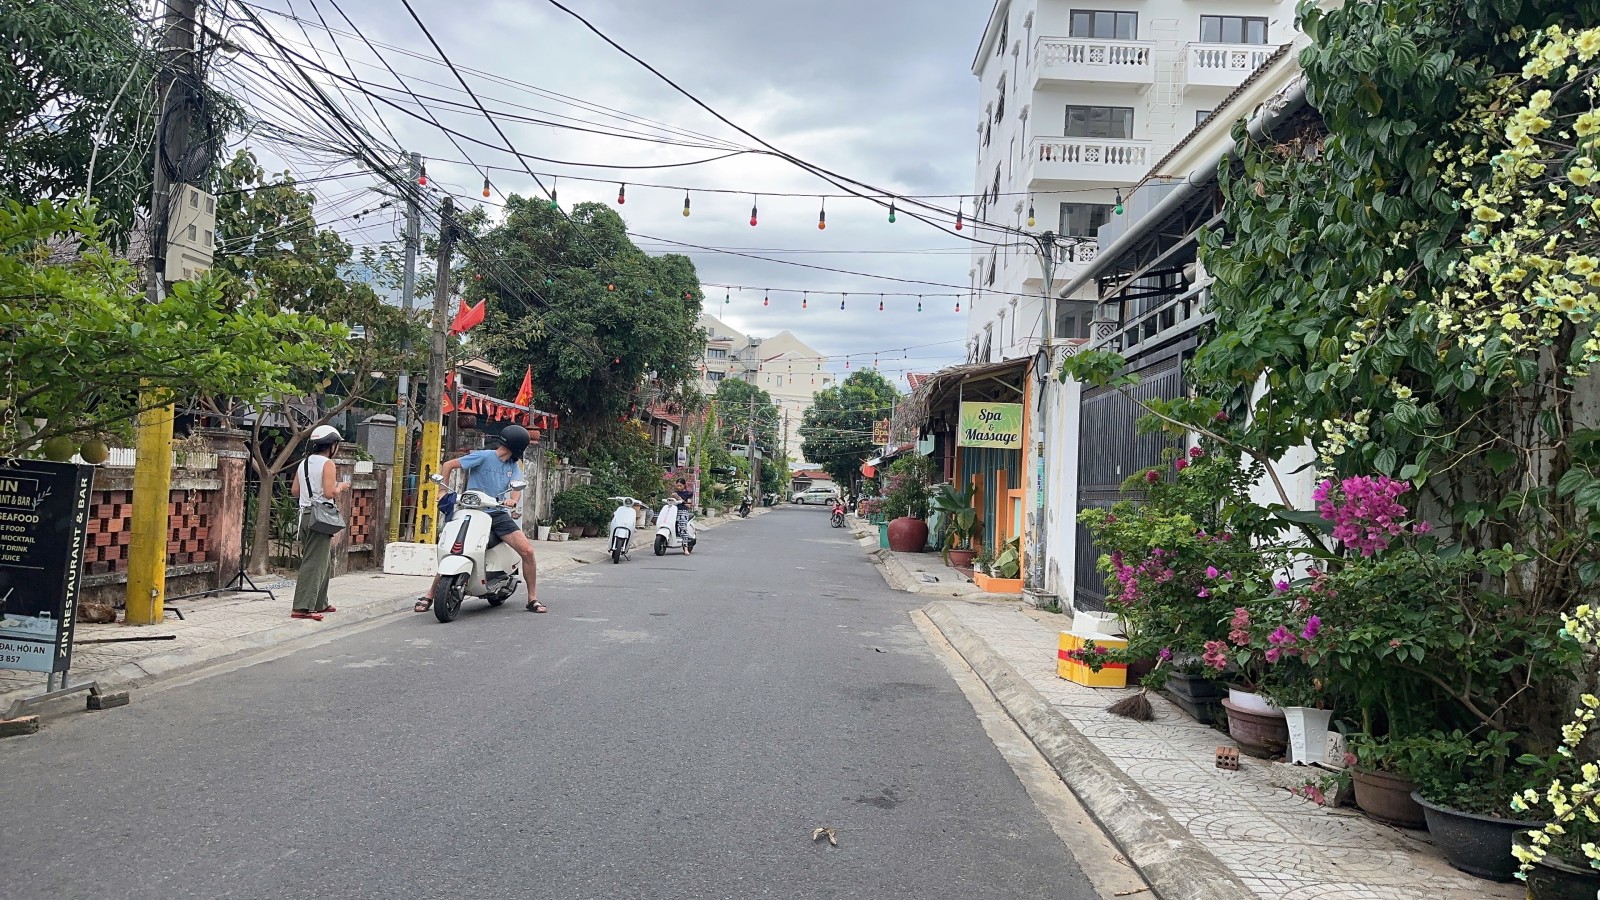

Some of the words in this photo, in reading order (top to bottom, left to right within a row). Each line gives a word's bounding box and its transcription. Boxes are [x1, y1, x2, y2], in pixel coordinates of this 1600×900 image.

[978, 408, 1003, 423] Spa
[965, 428, 1018, 445] Massage
[78, 477, 88, 509] BAR
[11, 495, 17, 505] &
[17, 496, 31, 506] BAR
[76, 512, 83, 523] &
[1, 535, 35, 543] MOCKTAIL
[1, 554, 21, 562] JUICE
[63, 527, 81, 628] RESTAURANT
[17, 644, 32, 654] HỘI
[60, 631, 69, 657] ZIN
